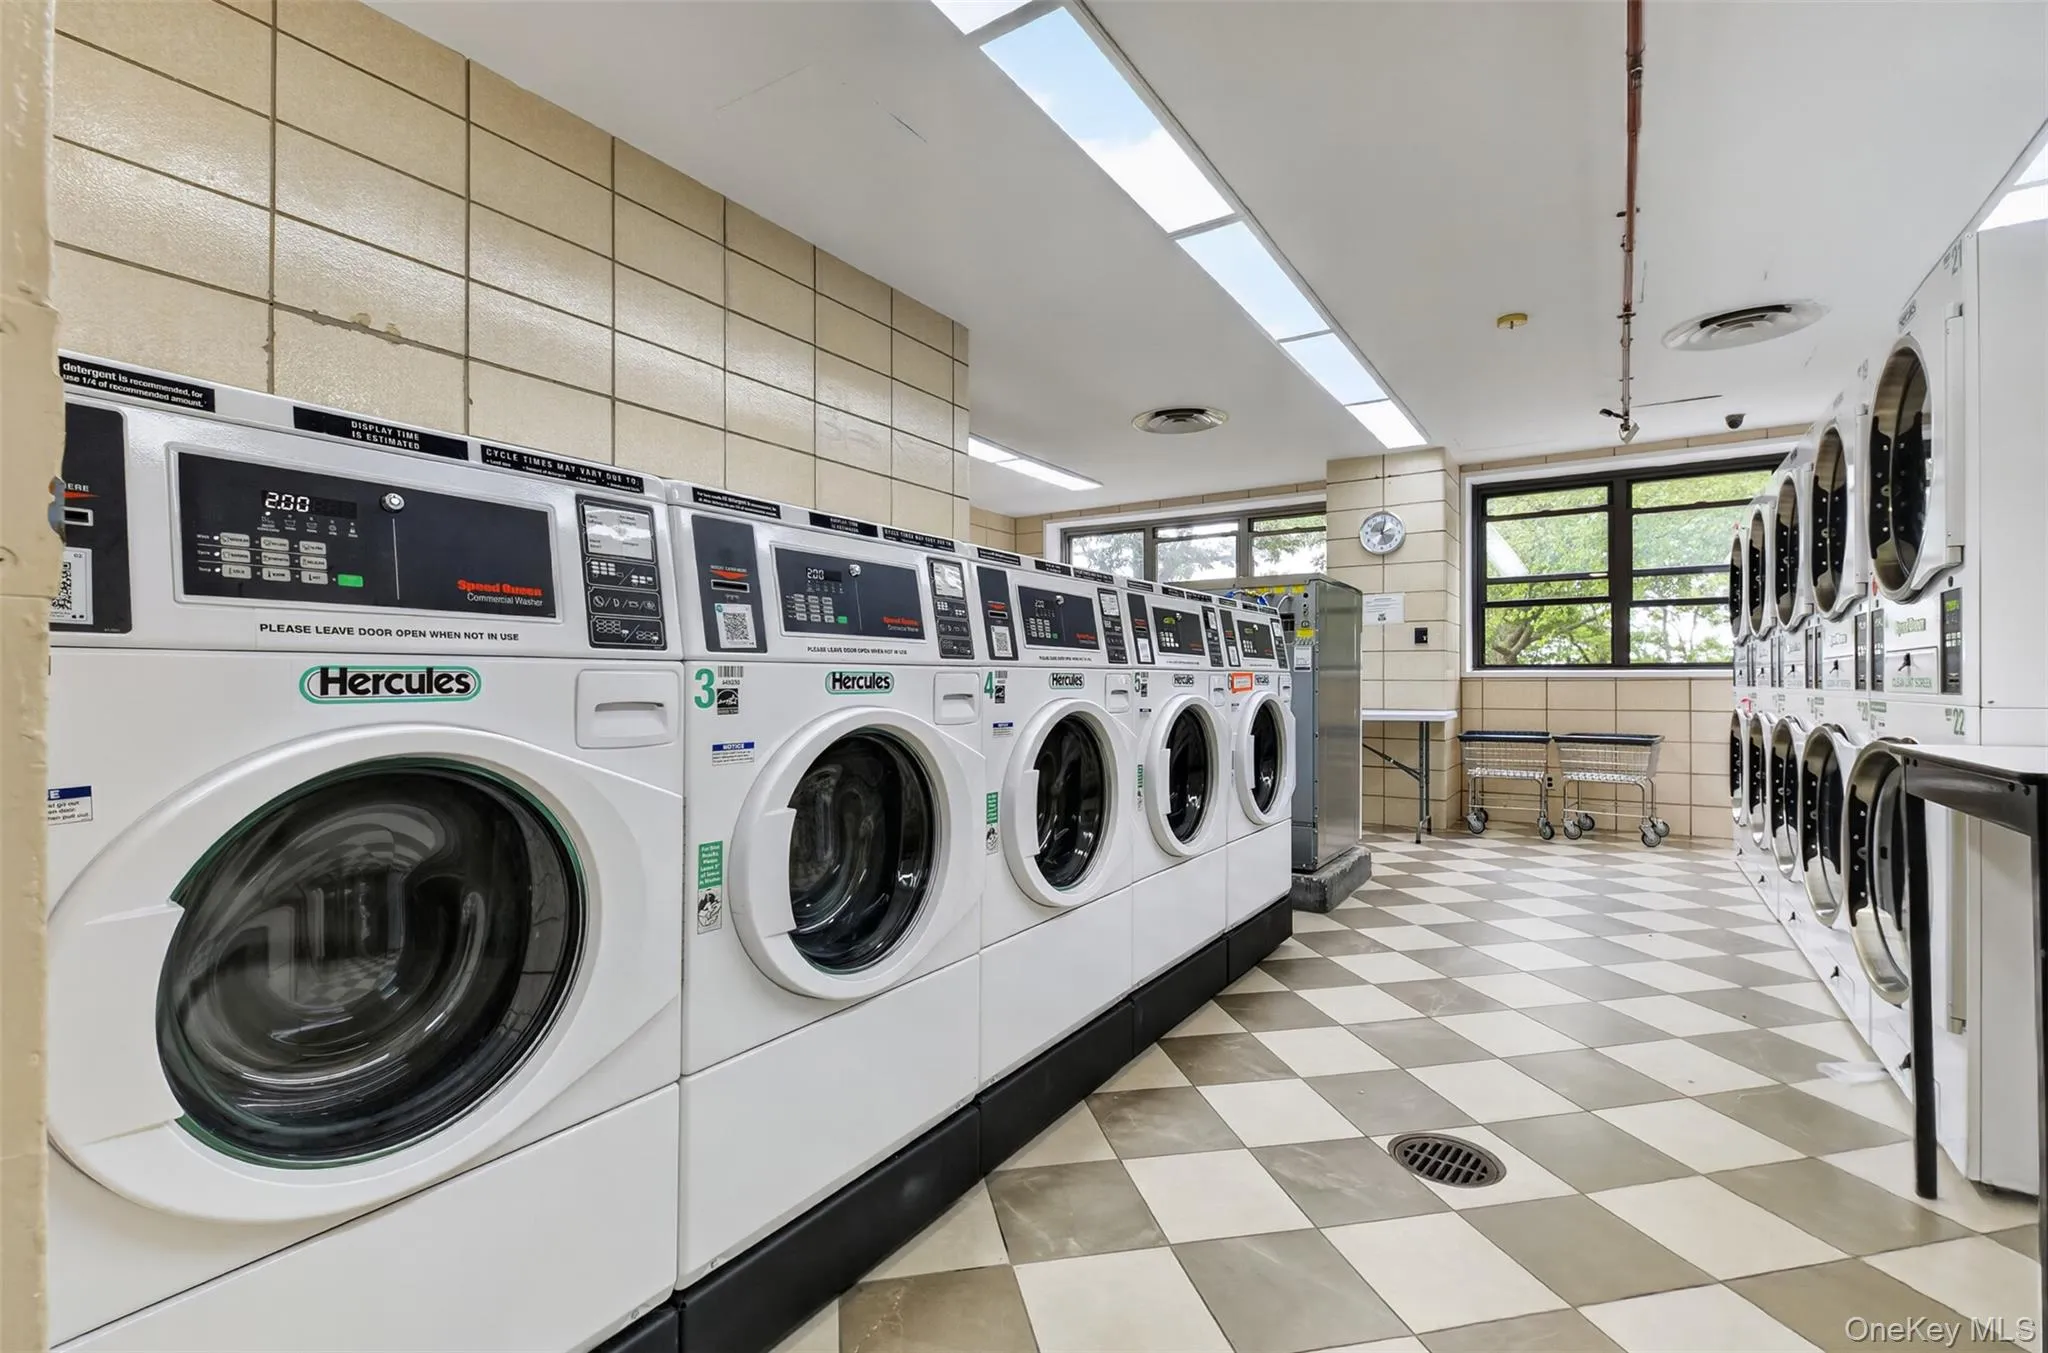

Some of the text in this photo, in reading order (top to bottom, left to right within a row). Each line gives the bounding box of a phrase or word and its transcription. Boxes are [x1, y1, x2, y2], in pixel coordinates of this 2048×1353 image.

[63, 362, 203, 398] detergent is recommended, for
[82, 376, 96, 386] 1/4
[98, 380, 108, 388] of
[109, 383, 170, 400] recommended
[351, 420, 420, 441] DISPLAY TIME
[352, 430, 420, 450] IS ESTIMATED
[486, 448, 518, 462] CYCLE
[523, 455, 553, 468] TIMES
[556, 462, 576, 473] MAY
[580, 467, 603, 478] VARY
[606, 472, 622, 483] DUE
[65, 482, 90, 492] ERE
[265, 492, 310, 512] 2.00
[456, 579, 501, 592] Speed
[466, 592, 543, 607] Commercial Washer
[260, 624, 520, 642] PLEASE LEAVE DOOR OPEN WHEN NOT IN USE
[320, 667, 471, 696] Hercules
[694, 668, 716, 709] 3
[832, 672, 891, 690] Hercules
[984, 672, 994, 699] 4
[1052, 672, 1082, 686] Hercules
[1953, 708, 1964, 736] 22
